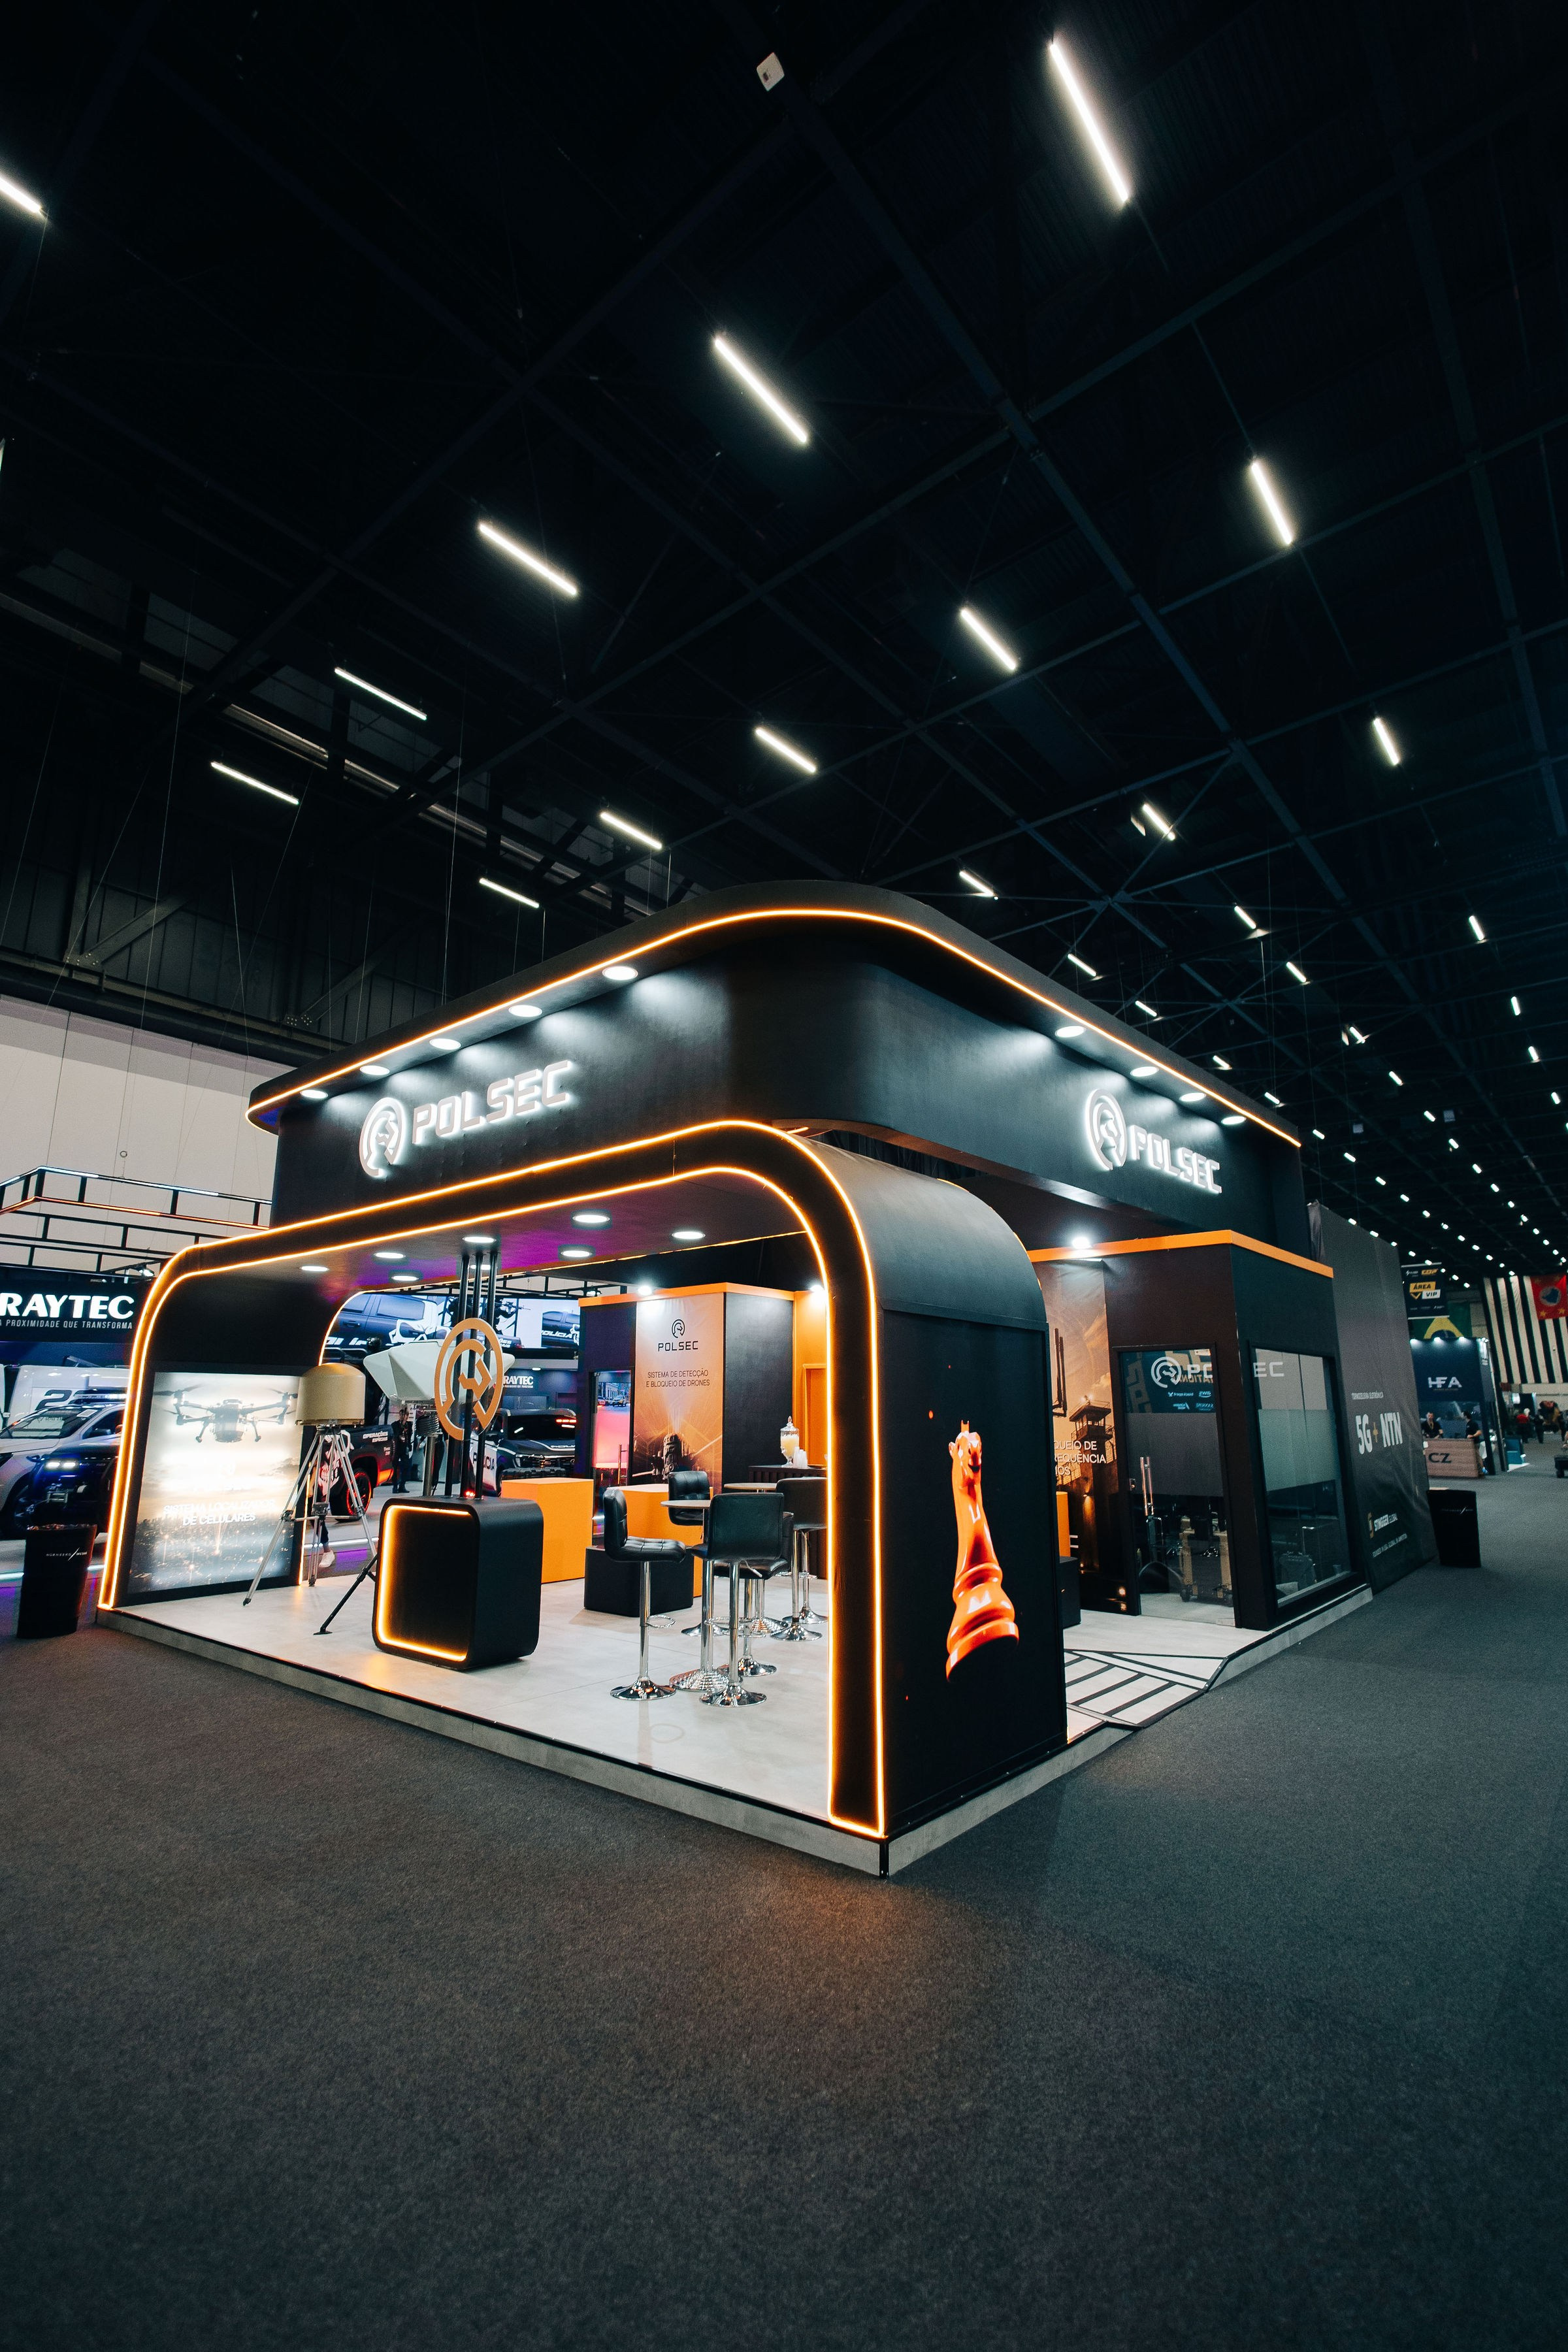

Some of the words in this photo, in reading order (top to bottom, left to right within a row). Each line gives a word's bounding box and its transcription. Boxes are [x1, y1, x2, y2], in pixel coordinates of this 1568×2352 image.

[412, 1060, 572, 1145] POLSEC
[1129, 1124, 1222, 1194] POLSEC
[0, 1292, 135, 1319] RAYTEC
[658, 1341, 698, 1352] POLSEC
[679, 1367, 709, 1379] DETECÇÃO
[504, 1375, 533, 1385] RAYTEC
[1428, 1377, 1462, 1388] HFA
[1356, 1414, 1373, 1454] 5G
[1380, 1412, 1403, 1448] NTN
[1084, 1441, 1097, 1450] DE
[1428, 1452, 1452, 1463] CZ
[182, 1517, 197, 1526] DE
[199, 1512, 256, 1525] CELULARES
